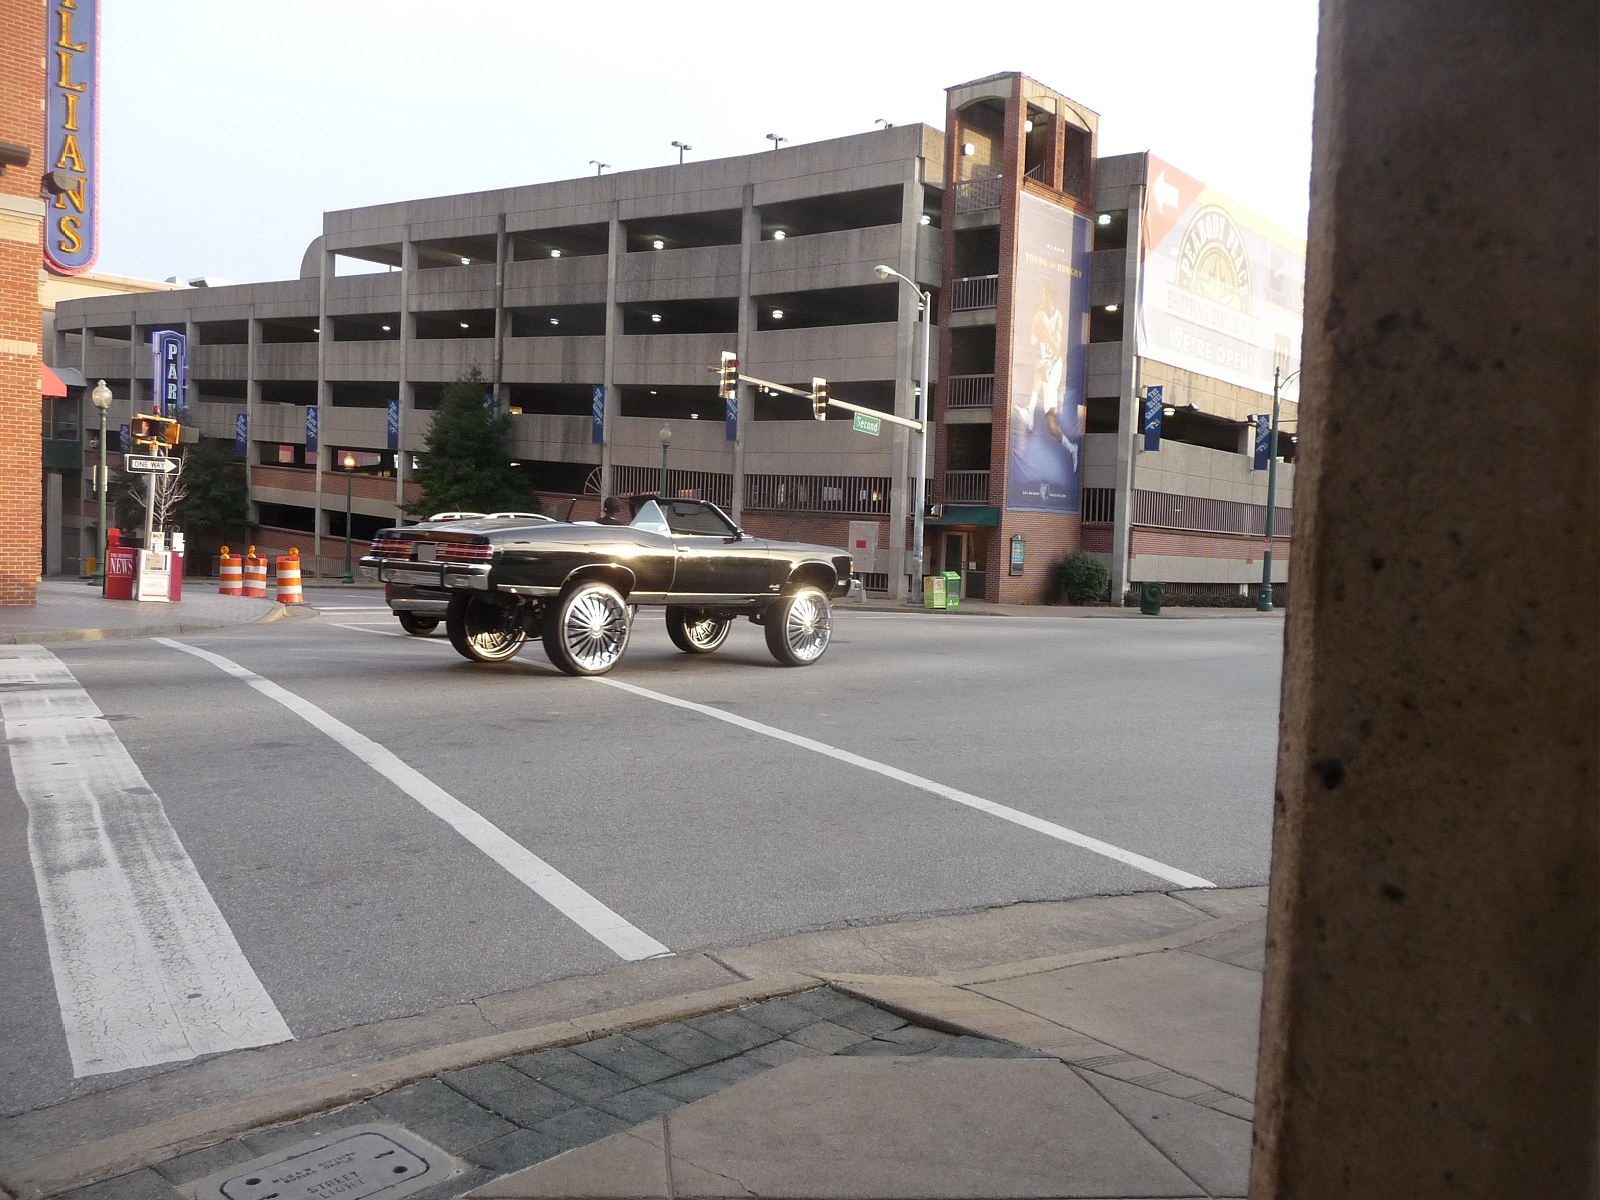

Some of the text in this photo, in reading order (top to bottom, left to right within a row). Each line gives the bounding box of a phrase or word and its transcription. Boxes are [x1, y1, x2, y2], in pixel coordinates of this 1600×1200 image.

[54, 0, 88, 254] LLIANS
[1025, 252, 1048, 267] YOUNG
[1180, 213, 1249, 298] PEABODY PLACE
[1169, 327, 1212, 360] WE'RE
[1216, 344, 1253, 374] OPEN!
[1147, 387, 1160, 399] THE
[856, 416, 879, 432] Second
[134, 460, 165, 469] ONE WAY
[109, 558, 133, 575] NEWS
[307, 1171, 360, 1194] STREET
[319, 1179, 365, 1199] LIGHT
